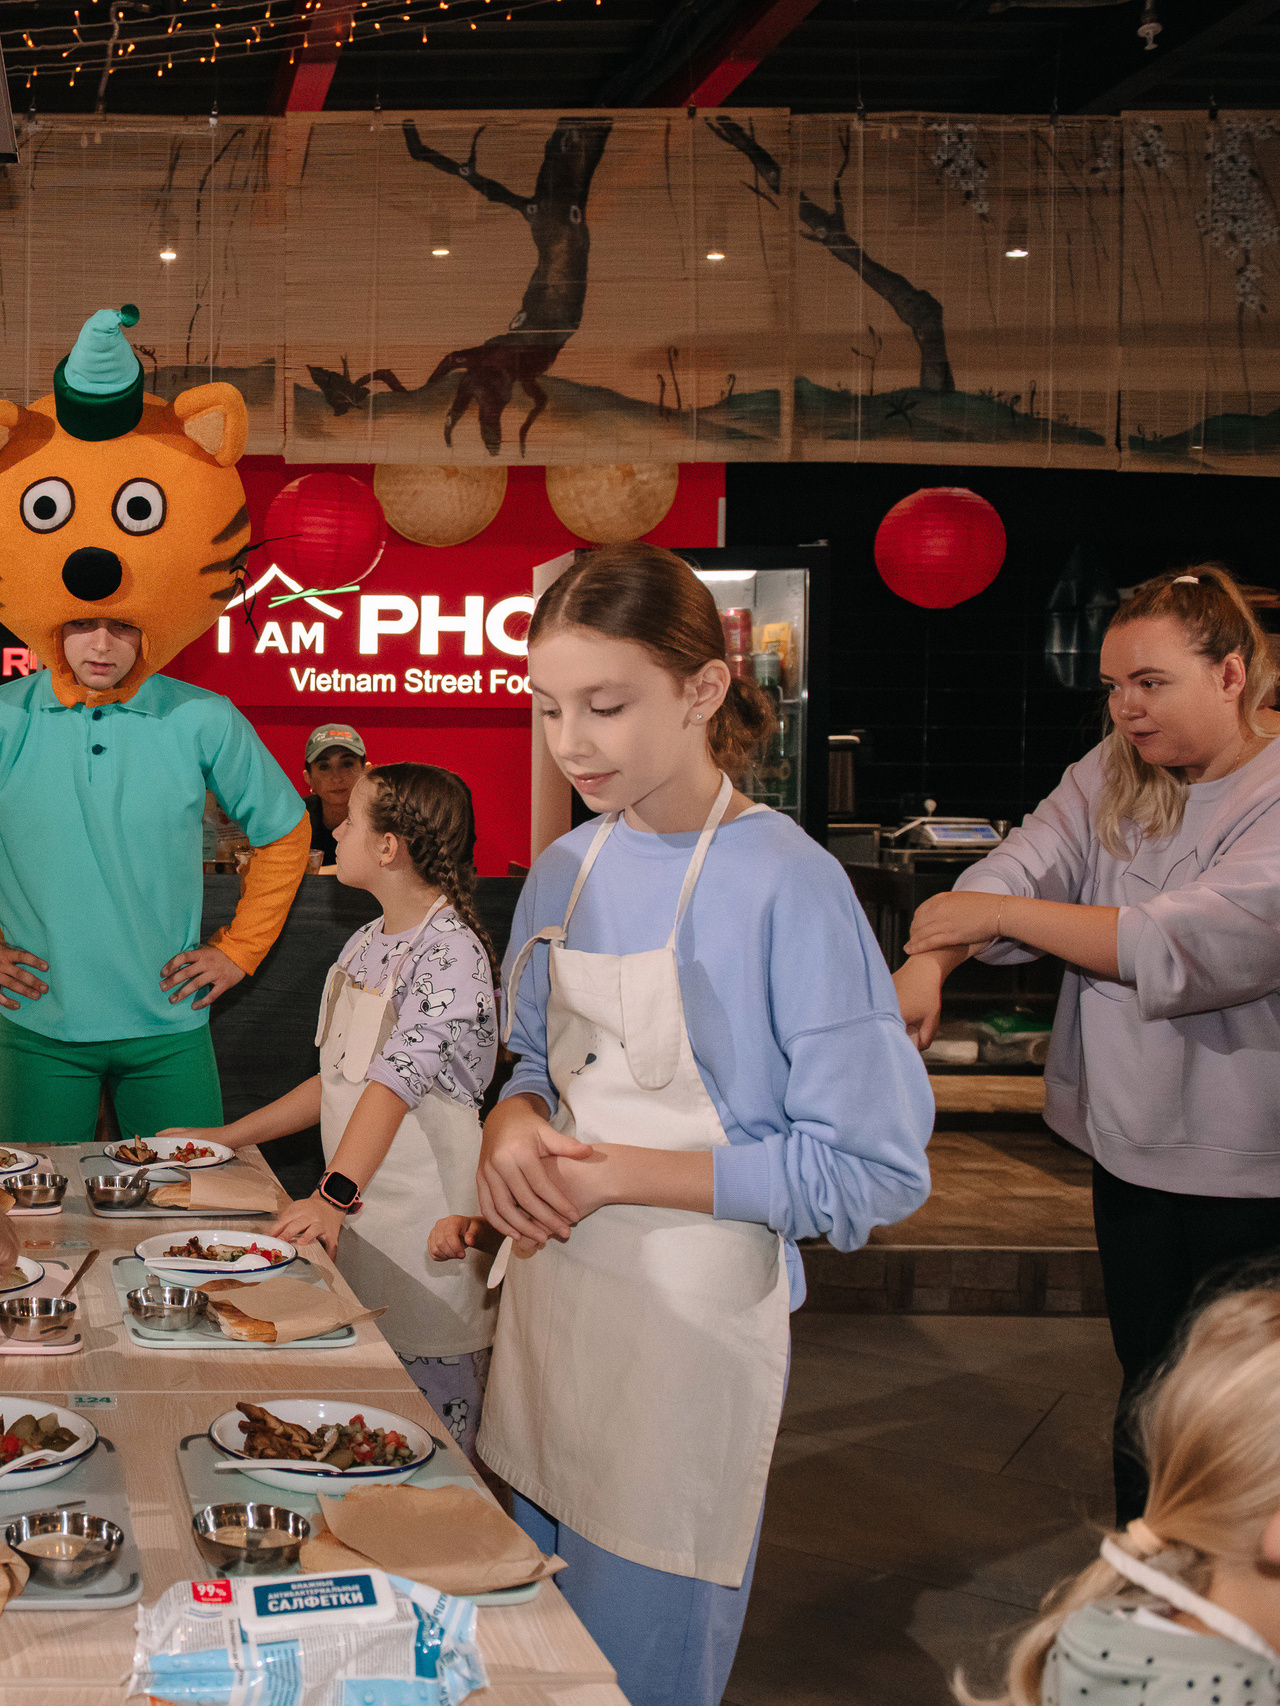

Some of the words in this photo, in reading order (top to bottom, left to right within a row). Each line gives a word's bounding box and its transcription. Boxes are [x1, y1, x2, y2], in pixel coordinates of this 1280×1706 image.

[217, 615, 230, 654] I
[254, 621, 325, 654] AM
[289, 667, 397, 693] Vietnam
[403, 668, 483, 694] Street
[74, 1396, 112, 1404] 124
[267, 1591, 365, 1613] САЛФЕТКИ
